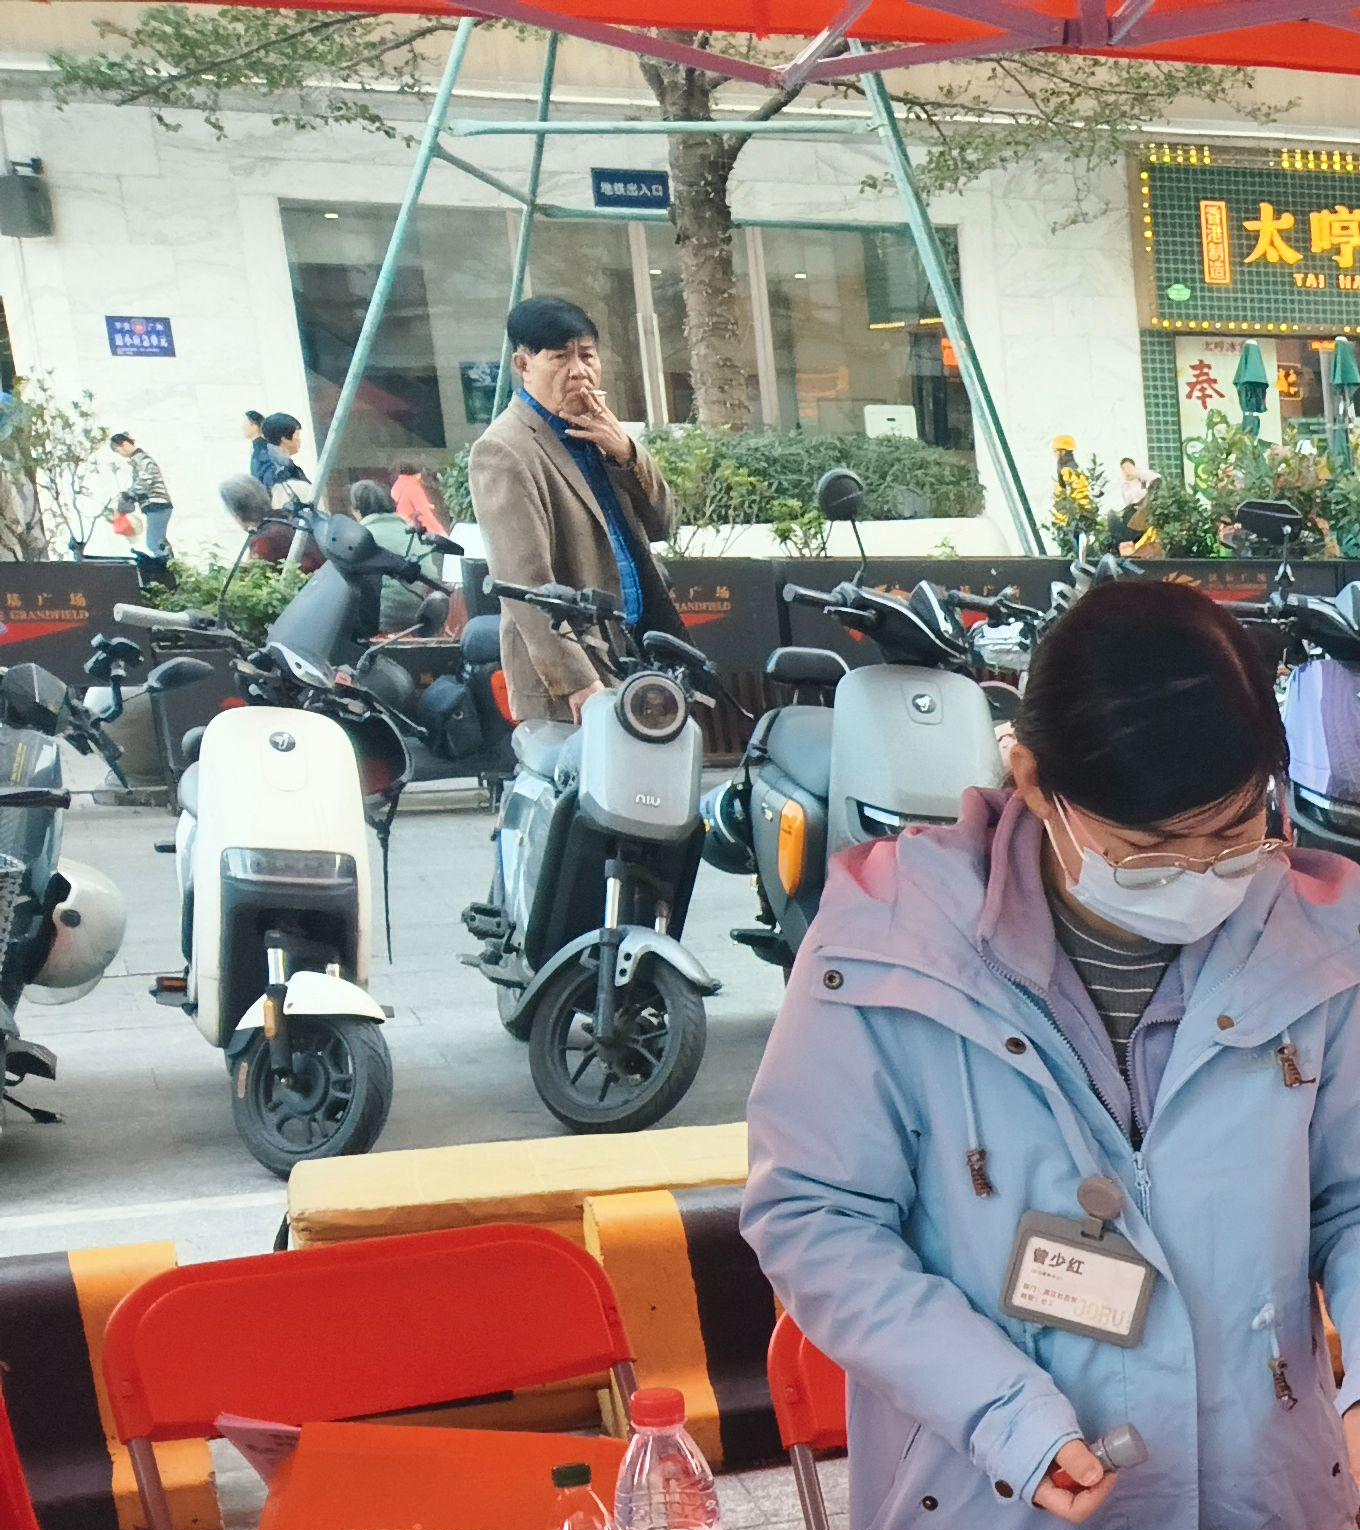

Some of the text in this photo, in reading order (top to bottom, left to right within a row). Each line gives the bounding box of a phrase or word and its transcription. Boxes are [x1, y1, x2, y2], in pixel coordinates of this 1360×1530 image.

[1294, 274, 1326, 288] TAI
[1185, 359, 1226, 410] 奉
[1033, 1247, 1085, 1275] 曾少红
